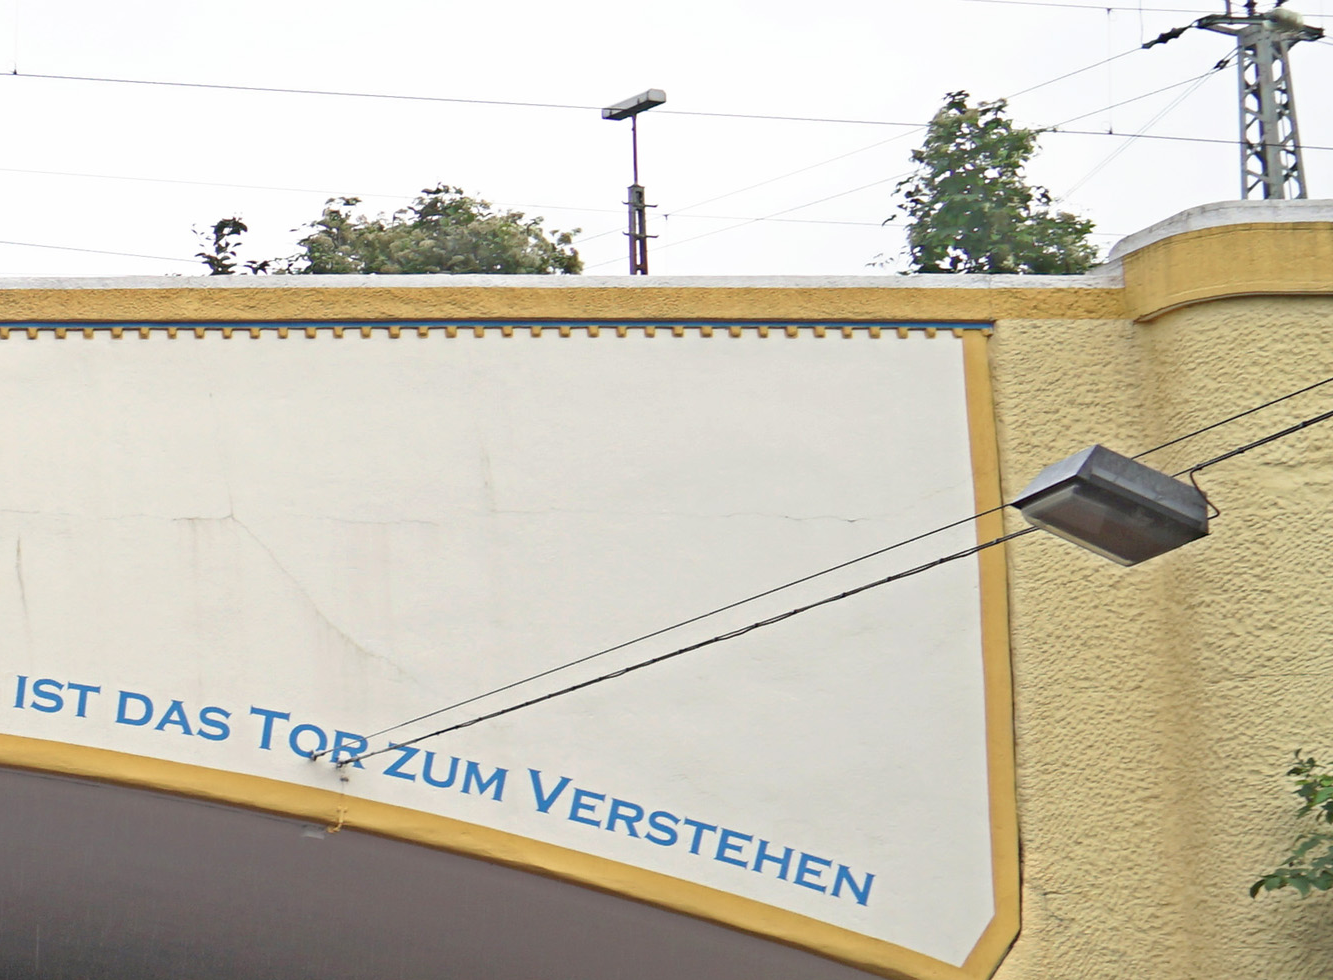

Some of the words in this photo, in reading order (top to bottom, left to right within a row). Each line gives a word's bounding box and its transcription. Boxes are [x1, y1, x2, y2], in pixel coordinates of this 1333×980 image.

[13, 675, 101, 718] IST
[115, 690, 232, 742] DAS
[249, 705, 369, 770] TOR
[382, 741, 508, 802] ZUM
[528, 768, 876, 906] VERSTEHEN
